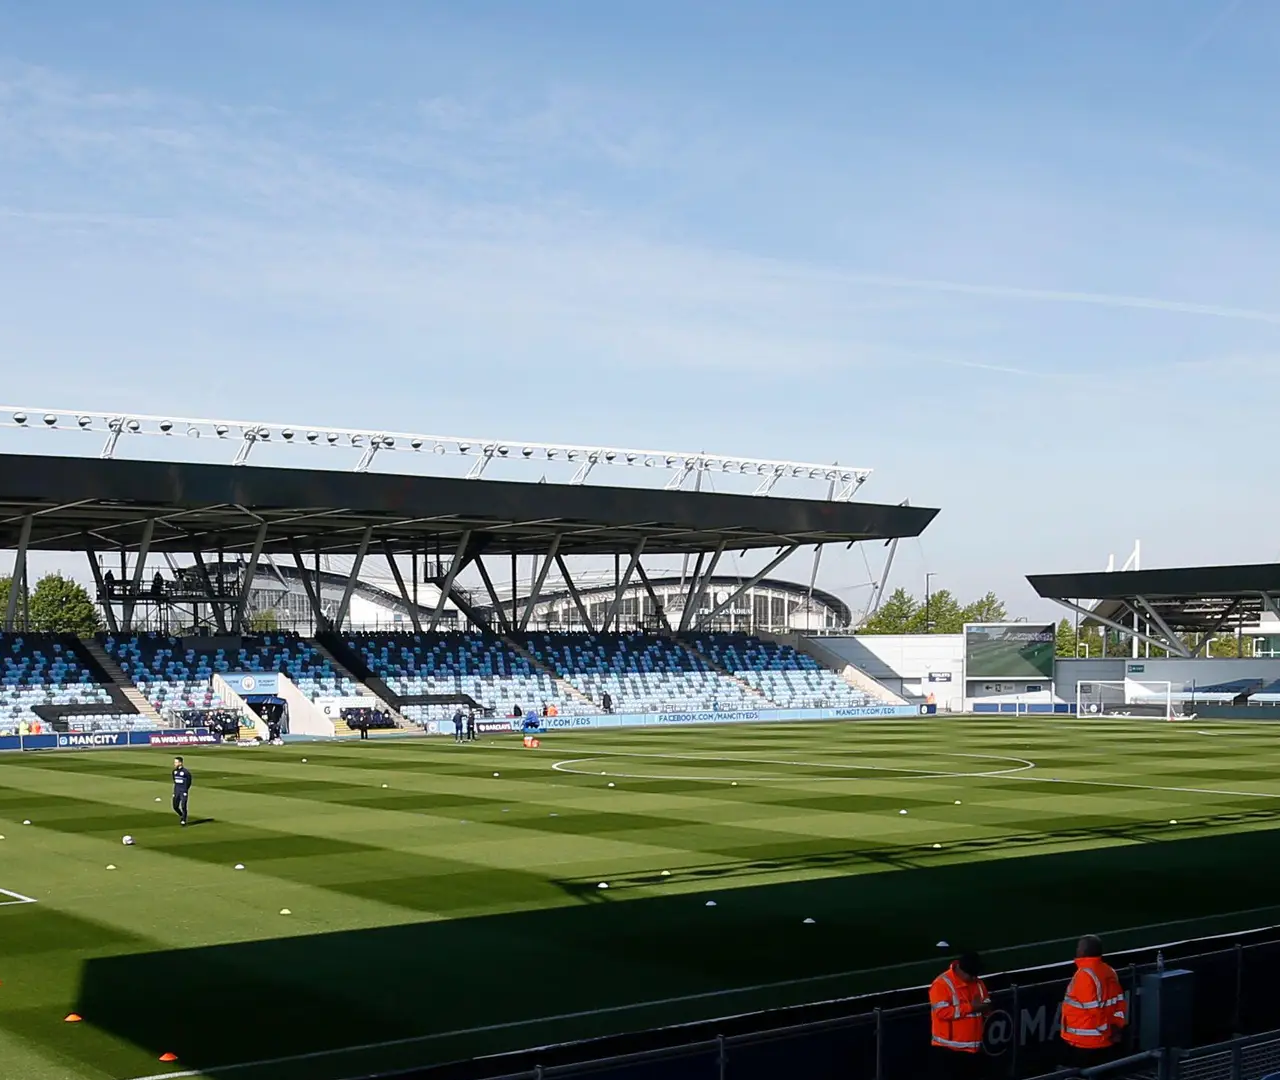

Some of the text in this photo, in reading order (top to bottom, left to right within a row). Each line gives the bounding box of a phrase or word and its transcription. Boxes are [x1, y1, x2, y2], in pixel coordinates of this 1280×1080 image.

[659, 712, 758, 722] FACEBOOK.COM/MANCITYEDS
[485, 723, 511, 731] BARCLAYS
[69, 734, 118, 745] MANCITY
